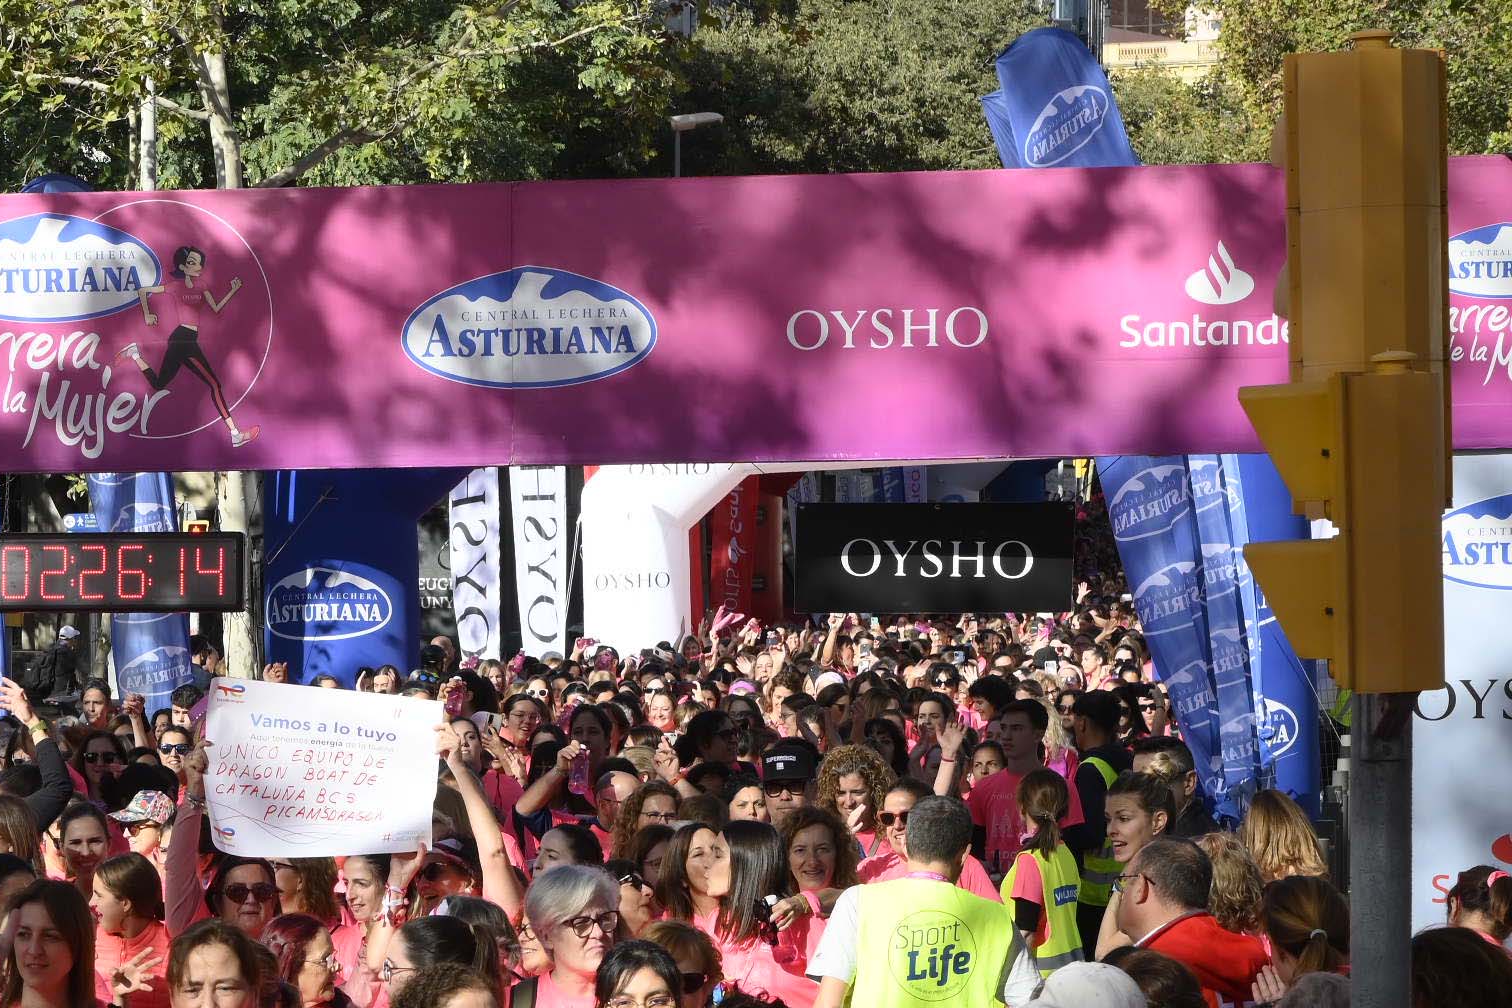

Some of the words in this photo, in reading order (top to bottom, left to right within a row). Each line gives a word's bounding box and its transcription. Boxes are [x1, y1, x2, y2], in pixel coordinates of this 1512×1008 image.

[461, 309, 540, 323] CENTRAL
[548, 307, 629, 320] LECHERA
[786, 305, 989, 351] OYSHO
[1119, 313, 1289, 348] Santande
[422, 313, 637, 358] ASTURIANA
[2, 374, 28, 414] la
[22, 365, 171, 459] Mujer
[841, 538, 1034, 580] OYSHO
[1442, 530, 1512, 566] ASTU
[1, 545, 224, 600] 02:26:14
[594, 571, 671, 592] OYSHO
[267, 596, 383, 624] ASTURIANA
[329, 591, 379, 601] LECHERA
[1416, 679, 1512, 722] OYS
[250, 713, 311, 732] Vamos
[317, 721, 328, 733] a
[334, 721, 350, 735] lo
[356, 725, 397, 743] tuyo
[215, 761, 289, 781] DRAGON
[303, 767, 350, 781] BOAT
[353, 771, 379, 786] DE
[291, 749, 354, 768] EQUIPO
[363, 754, 387, 769] DE
[215, 782, 306, 802] CATALUÑA
[895, 920, 961, 952] Sport
[906, 943, 971, 986] Life
